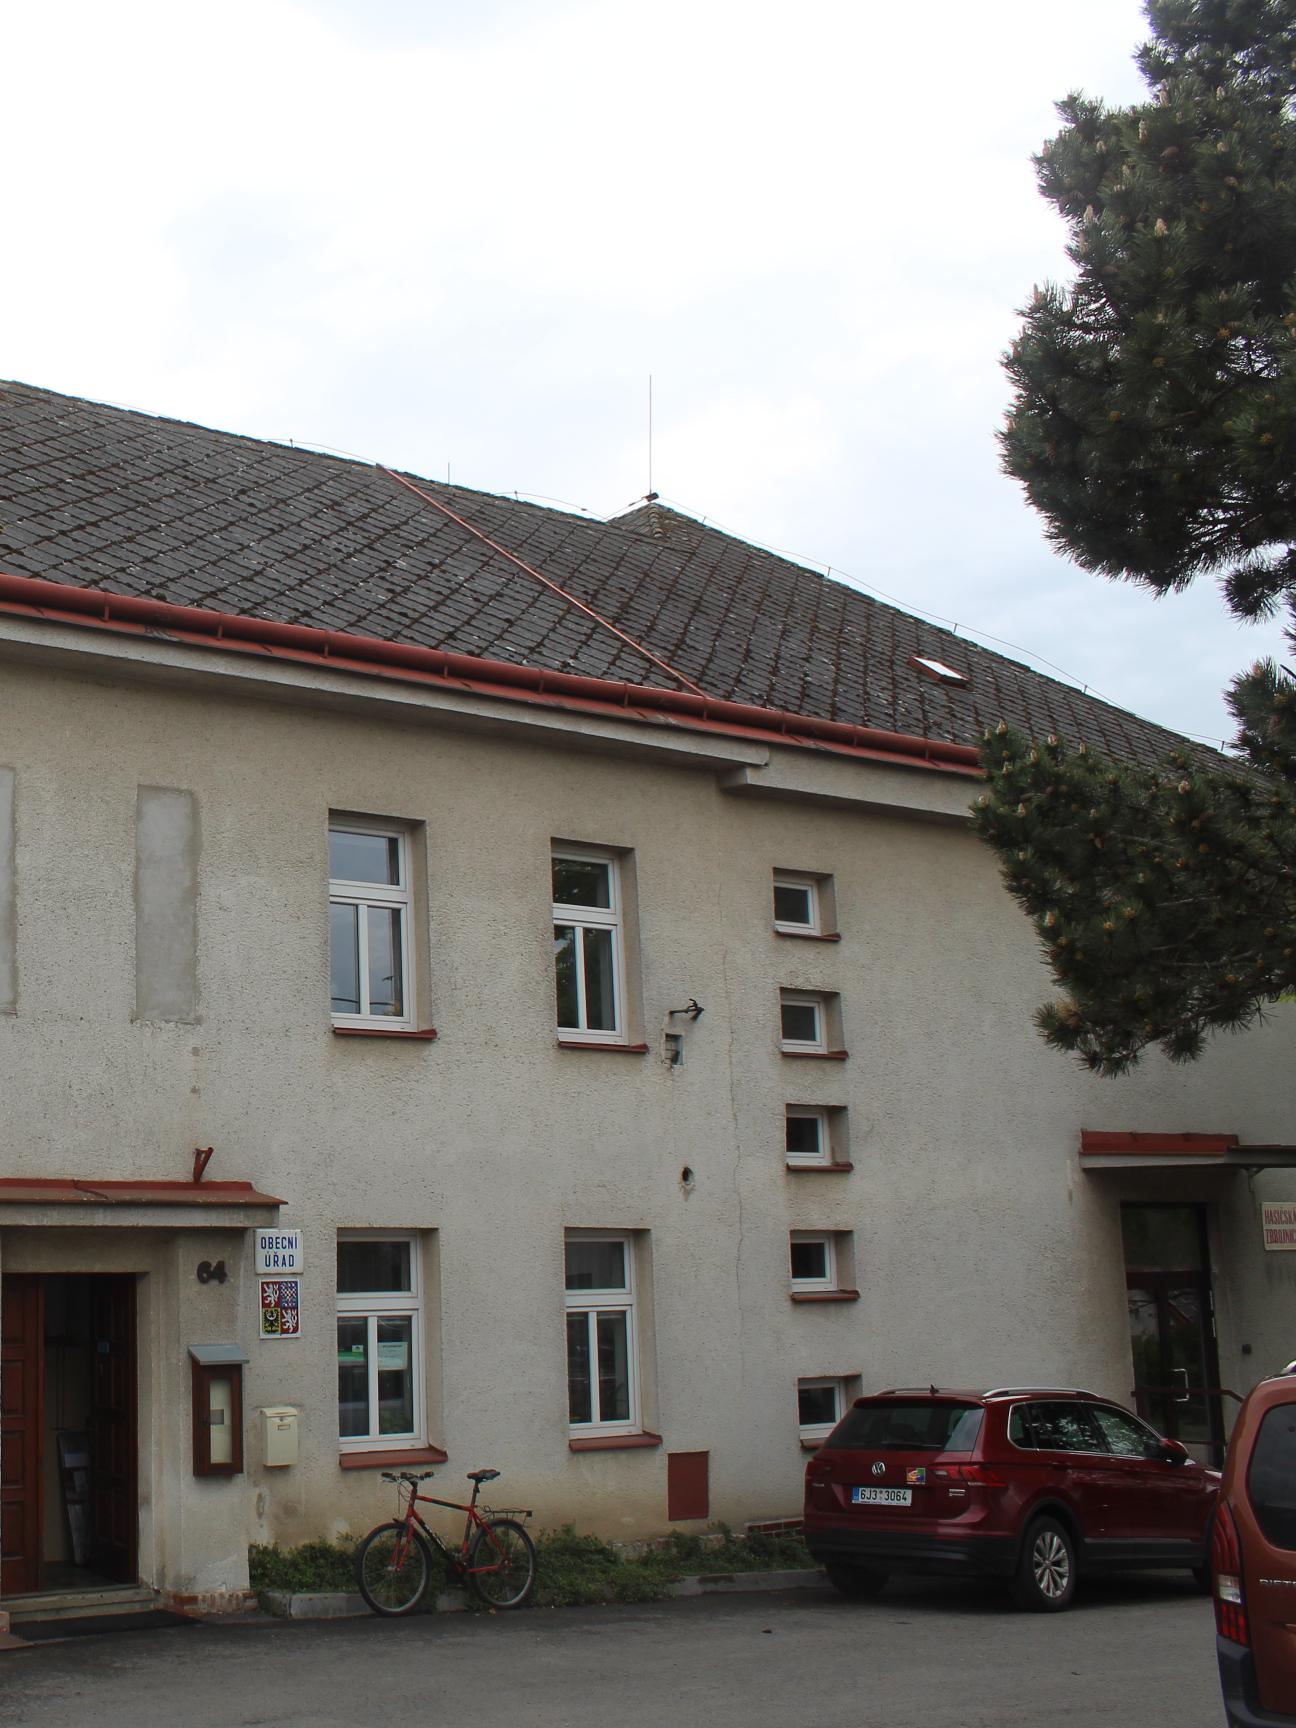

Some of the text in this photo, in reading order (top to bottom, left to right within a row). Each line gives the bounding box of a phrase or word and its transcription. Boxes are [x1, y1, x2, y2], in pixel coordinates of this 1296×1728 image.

[260, 1232, 298, 1250] OBECNÍ
[264, 1251, 295, 1268] ÚŘAD
[196, 1260, 228, 1285] 64
[860, 1489, 878, 1501] 6J3
[884, 1490, 907, 1502] 3064
